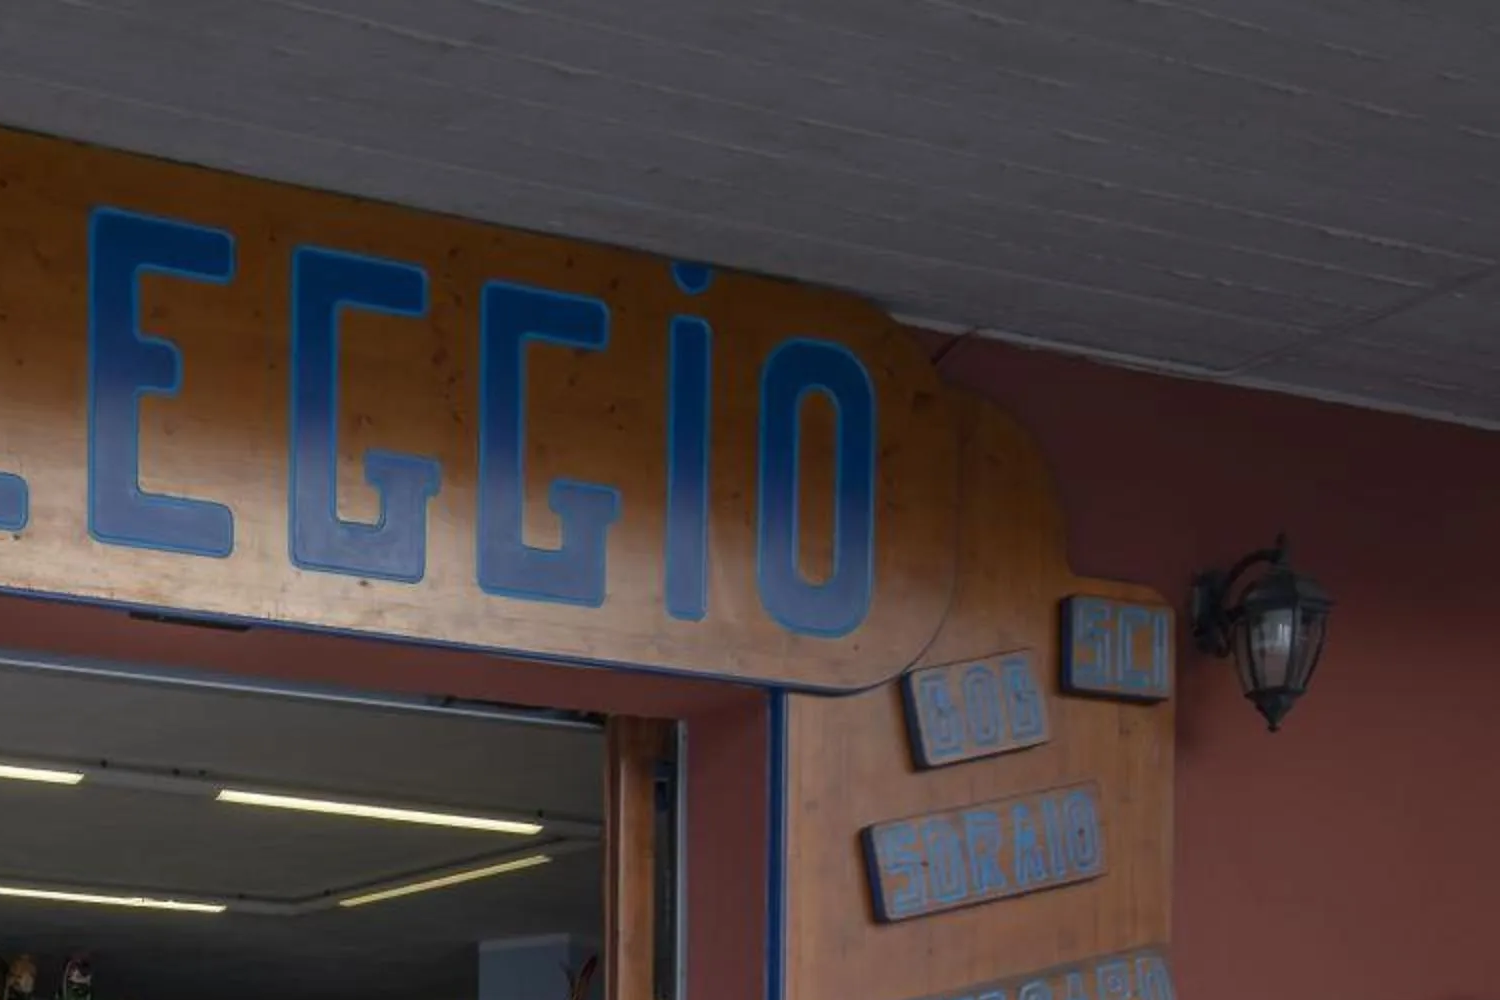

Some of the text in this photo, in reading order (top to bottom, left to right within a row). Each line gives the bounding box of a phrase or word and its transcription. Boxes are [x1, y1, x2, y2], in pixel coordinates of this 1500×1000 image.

[1073, 599, 1168, 691] SCI
[920, 658, 1044, 756] BOB
[883, 791, 1101, 912] SDRAIO
